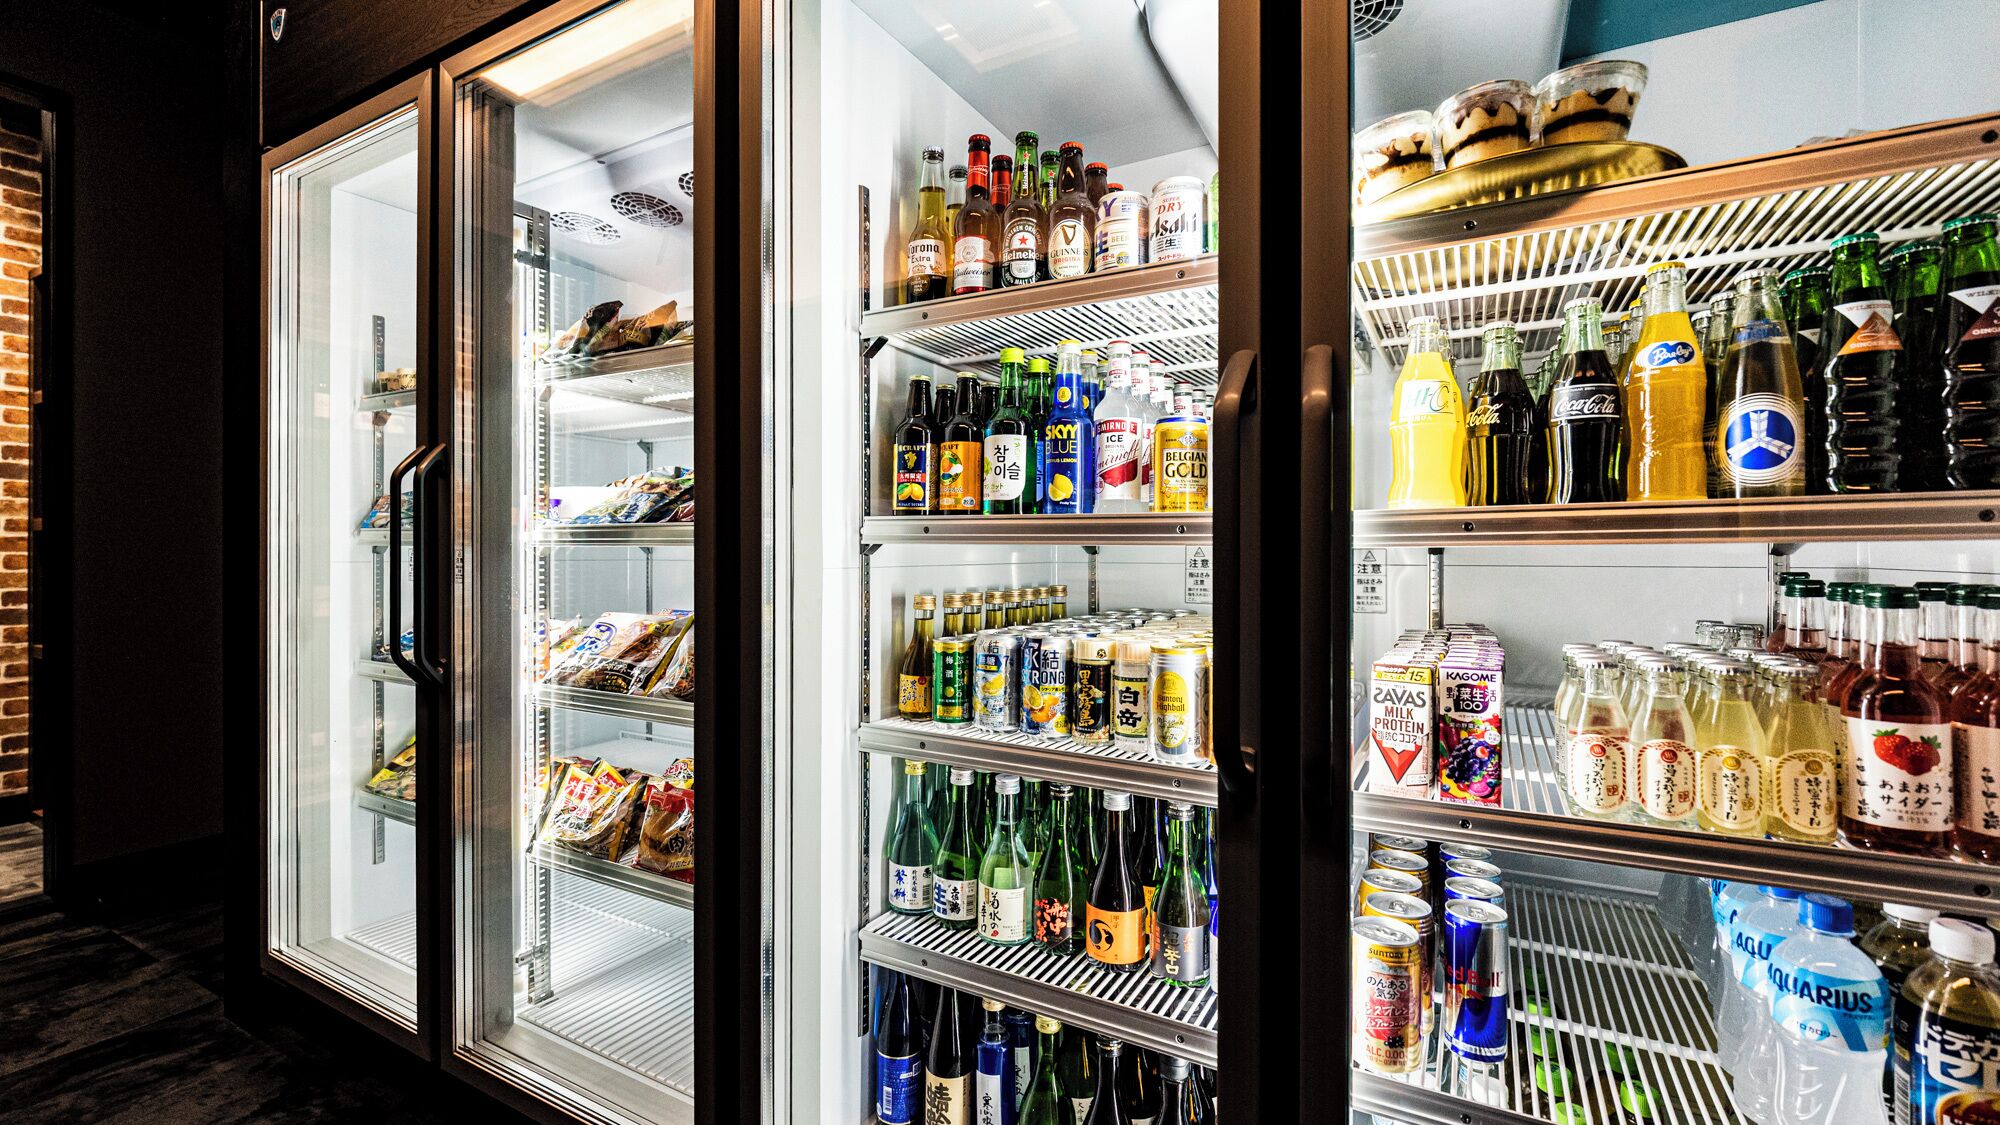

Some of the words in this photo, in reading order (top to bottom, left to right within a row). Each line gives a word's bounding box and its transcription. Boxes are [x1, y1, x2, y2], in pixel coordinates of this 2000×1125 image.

[1157, 202, 1184, 215] DRY
[1150, 212, 1197, 241] Asahi
[1165, 238, 1177, 248] 生
[911, 254, 931, 264] Extra
[1002, 249, 1044, 263] Heineken
[1554, 394, 1616, 417] Coca-Cola
[1045, 424, 1077, 440] SKYY
[1106, 434, 1124, 443] ICE
[993, 445, 1010, 463] 참
[1045, 440, 1077, 454] BLUE
[1165, 451, 1207, 462] BELGIAN
[993, 461, 1021, 481] 이슬
[1165, 462, 1208, 478] GOLD
[1189, 558, 1210, 569] 注意
[1357, 563, 1382, 574] 注意
[1446, 672, 1497, 683] KAGOME
[1373, 687, 1426, 708] SAVAS
[1446, 686, 1497, 702] 野菜生活
[1116, 686, 1142, 728] 白岳
[1384, 705, 1414, 721] MILK
[1460, 700, 1483, 711] 100
[1374, 717, 1425, 735] PROTEIN
[1879, 780, 1943, 794] あまおう
[1880, 795, 1943, 809] サイダー
[934, 882, 948, 907] 生
[949, 887, 962, 915] 土佐鶴
[988, 891, 1002, 930] 菊水の
[1366, 976, 1407, 990] のんある
[1767, 961, 1873, 1014] AQUARIUS
[1375, 987, 1400, 1000] 気分
[1797, 1020, 1838, 1038] ロカロリー
